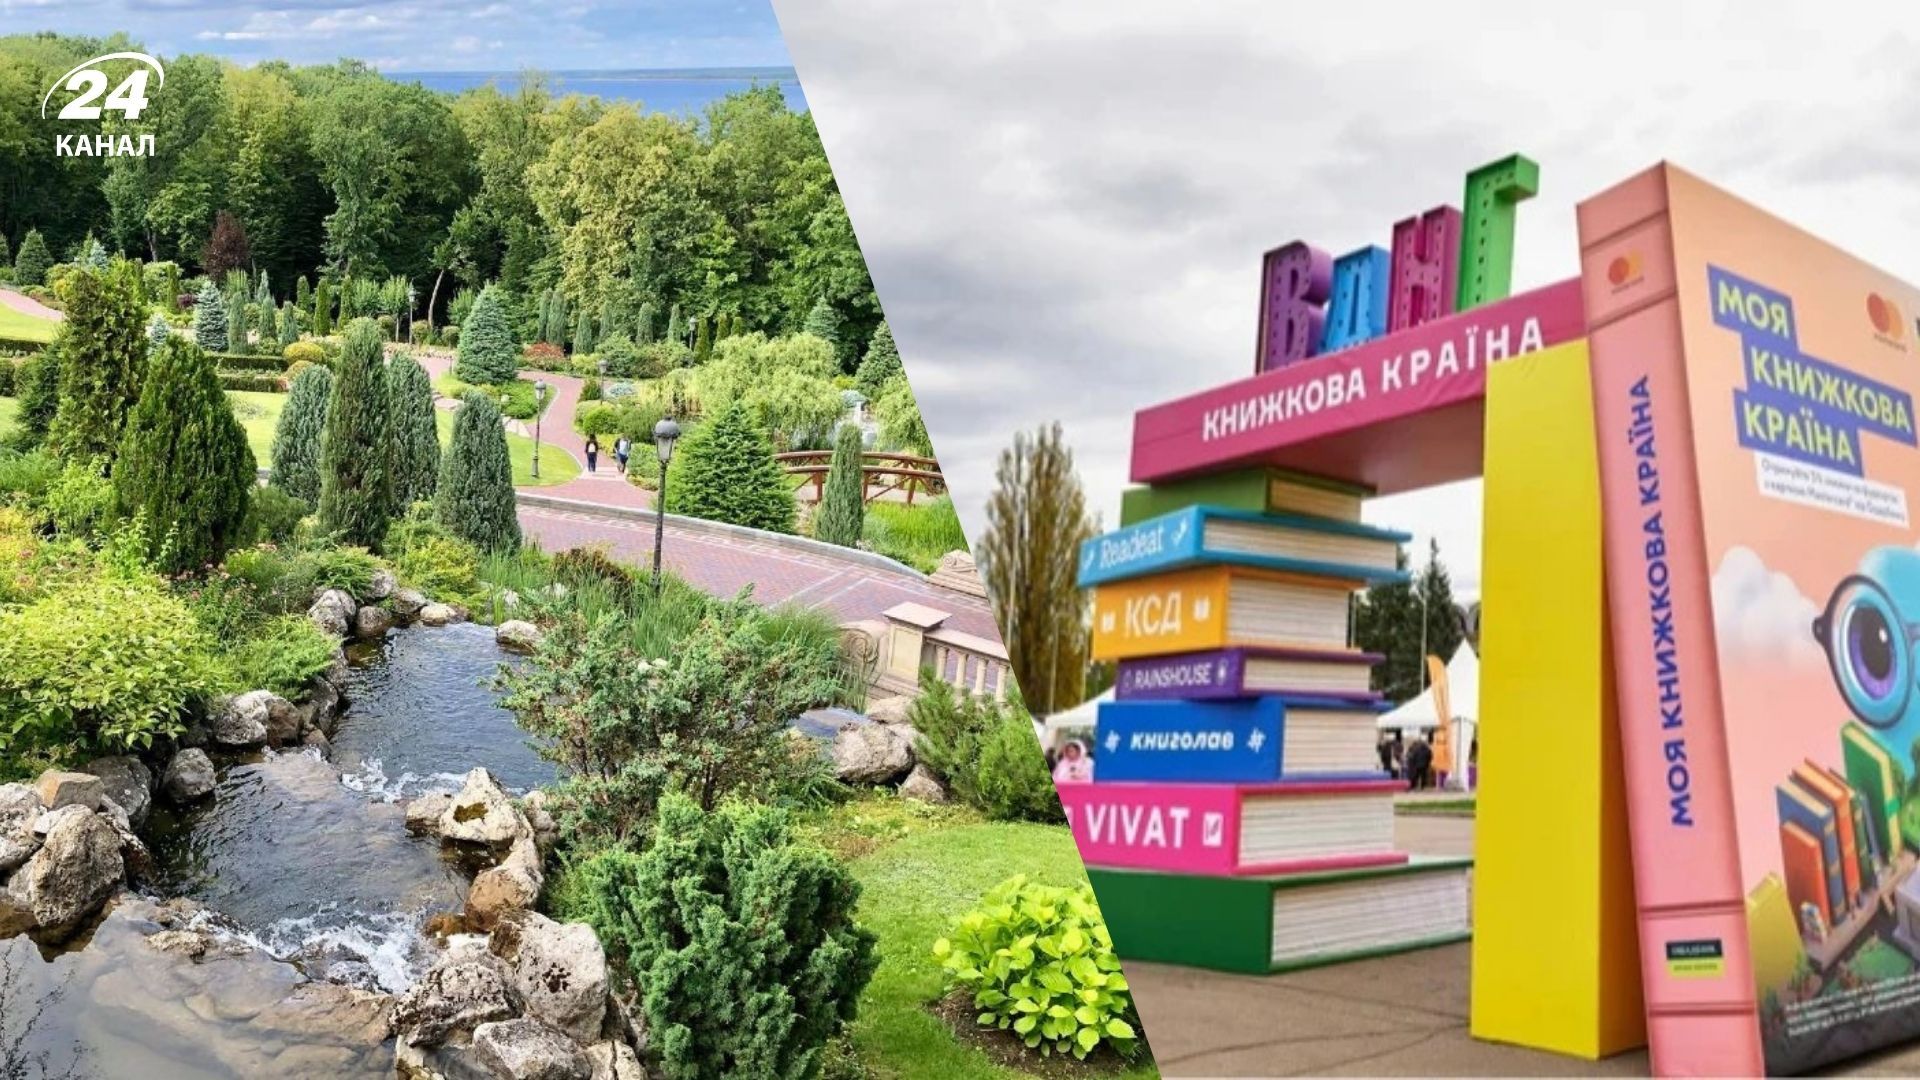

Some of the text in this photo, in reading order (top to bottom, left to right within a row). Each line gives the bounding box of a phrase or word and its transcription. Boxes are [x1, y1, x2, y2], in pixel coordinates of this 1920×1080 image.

[1255, 153, 1540, 375] ВДНГ
[1717, 279, 1791, 339] МОЯ
[1202, 316, 1545, 442] КНИЖКОВА КРАЇНА
[1750, 346, 1912, 433] КНИЖКОВА
[1744, 399, 1856, 467] КРАЇНА
[1100, 524, 1164, 569] Readeat
[1123, 590, 1182, 638] КСД
[1628, 374, 1693, 827] МОЯ КНИЖКОВА КРАЇНА
[1135, 661, 1212, 690] RAINSHOUSE
[1130, 730, 1235, 750] книголав
[1085, 803, 1191, 848] VIVAT
